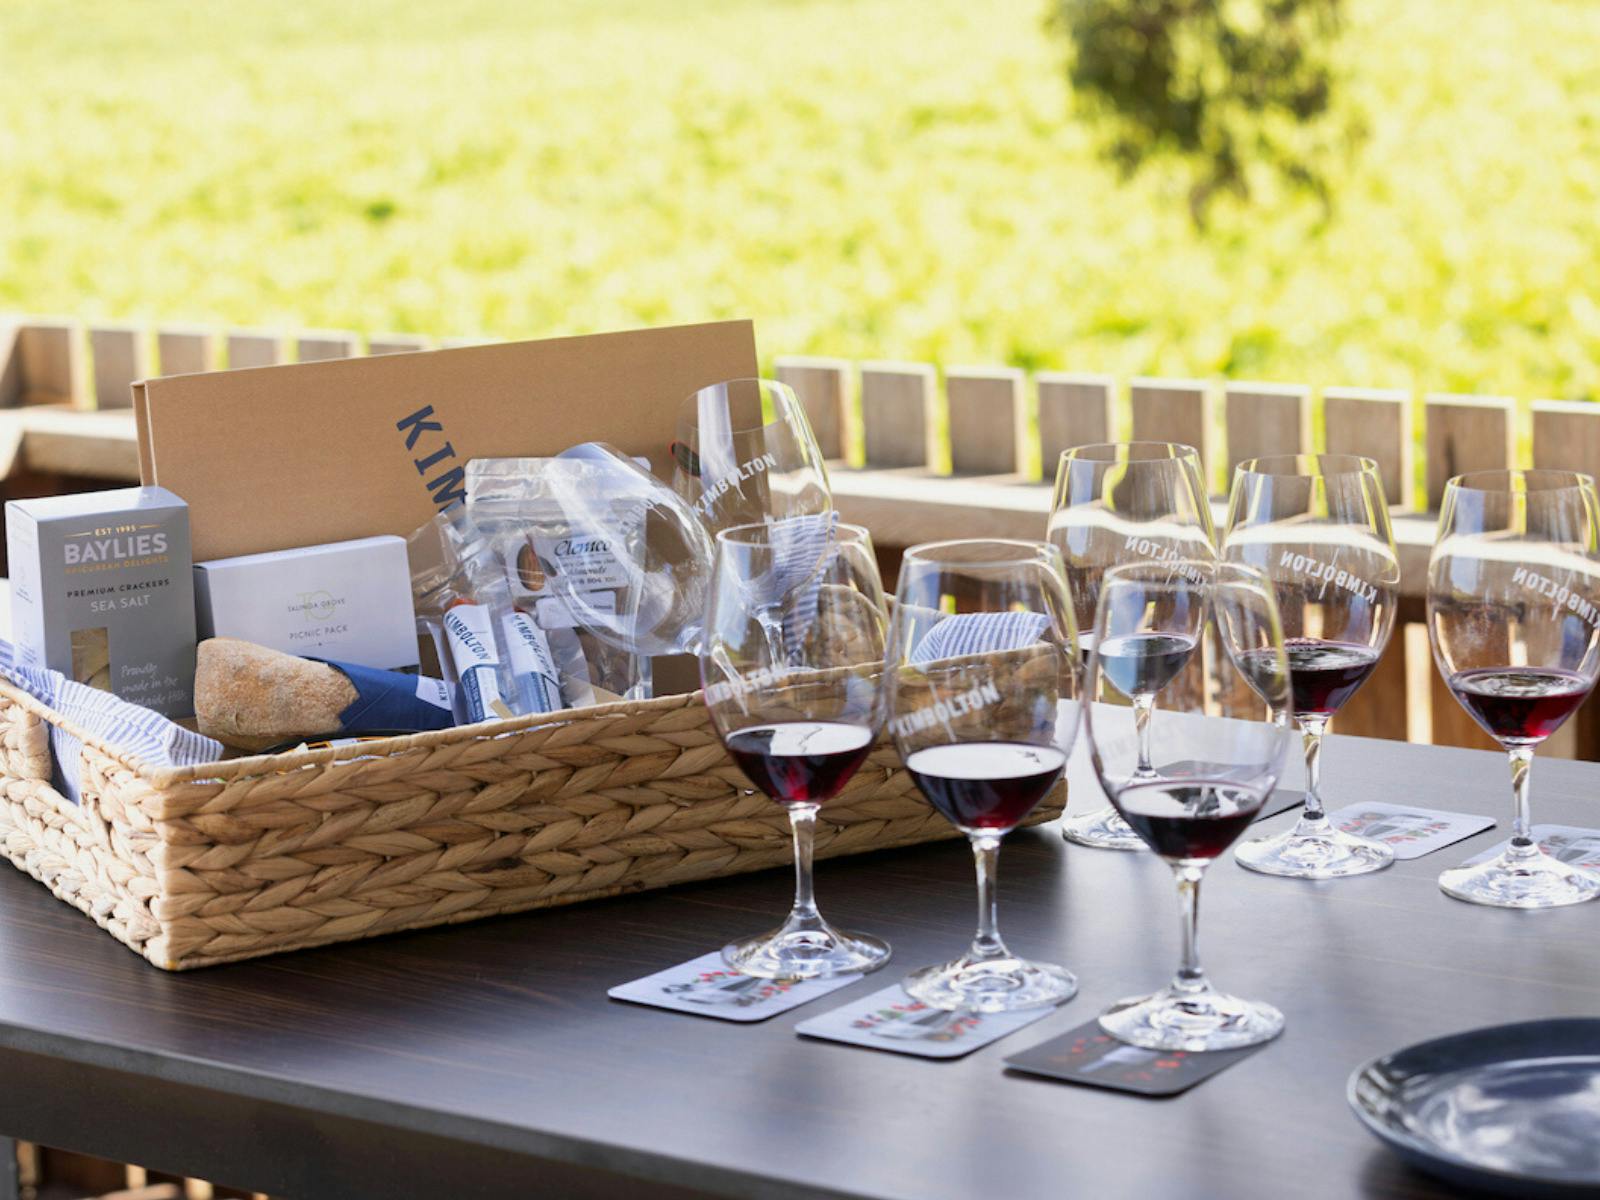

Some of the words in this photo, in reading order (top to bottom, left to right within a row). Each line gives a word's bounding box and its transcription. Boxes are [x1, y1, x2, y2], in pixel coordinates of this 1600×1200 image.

[692, 452, 777, 517] KIMBOLTON
[95, 528, 112, 537] EST
[116, 524, 137, 534] 1995
[64, 532, 169, 565] BAYLIES
[67, 586, 116, 598] PREMIUM
[120, 578, 170, 592] CRACKERS
[91, 600, 116, 612] SEA
[120, 595, 151, 608] SALT
[289, 628, 321, 640] PICNIC
[324, 625, 348, 634] PACK
[445, 611, 491, 660] KIMBOLTON
